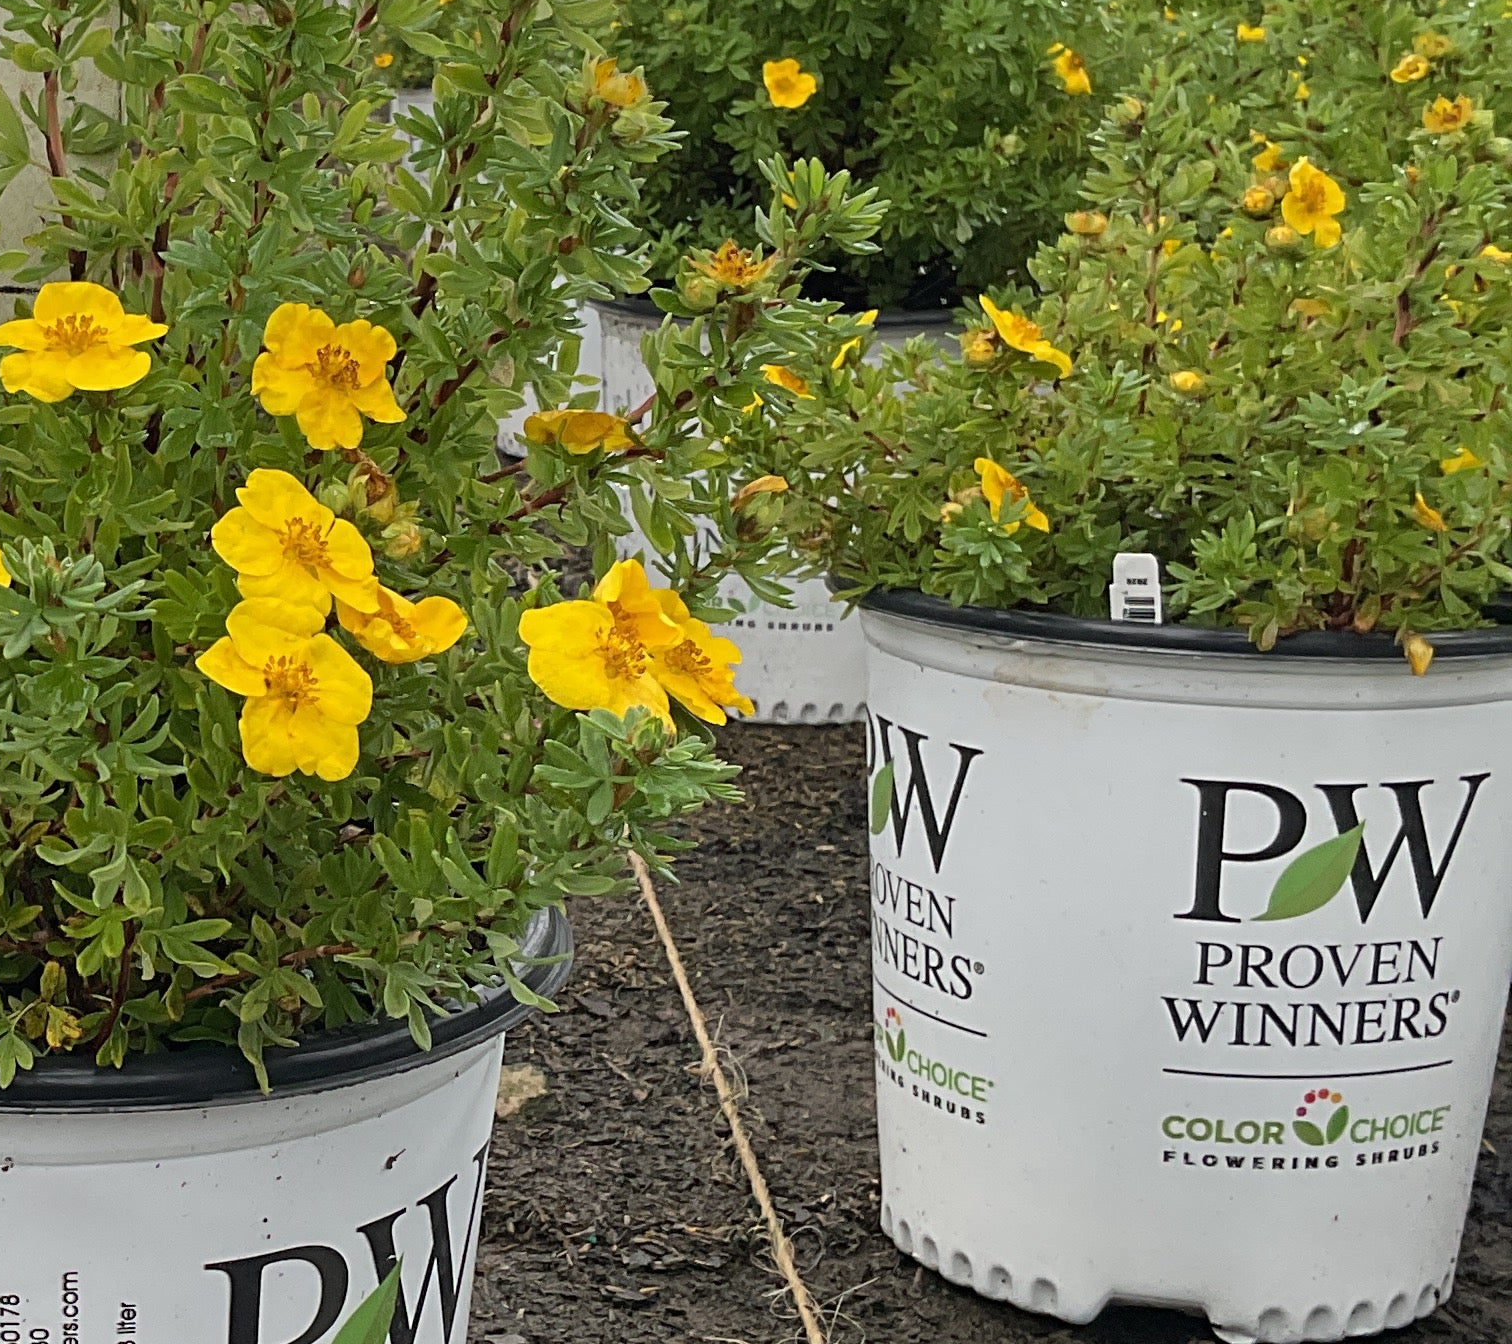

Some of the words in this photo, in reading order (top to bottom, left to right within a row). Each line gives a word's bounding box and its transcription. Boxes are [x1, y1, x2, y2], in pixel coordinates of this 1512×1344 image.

[1173, 772, 1491, 924] PW
[871, 859, 957, 941] OVEN
[872, 916, 985, 1001] NNERS®
[1192, 937, 1444, 989] PROVEN
[912, 1087, 987, 1125] SHRUBS
[1162, 1114, 1285, 1146] COLOR
[1163, 1149, 1339, 1170] FLOWERING
[1355, 1141, 1440, 1166] SHRUBS
[116, 1302, 138, 1335] liter
